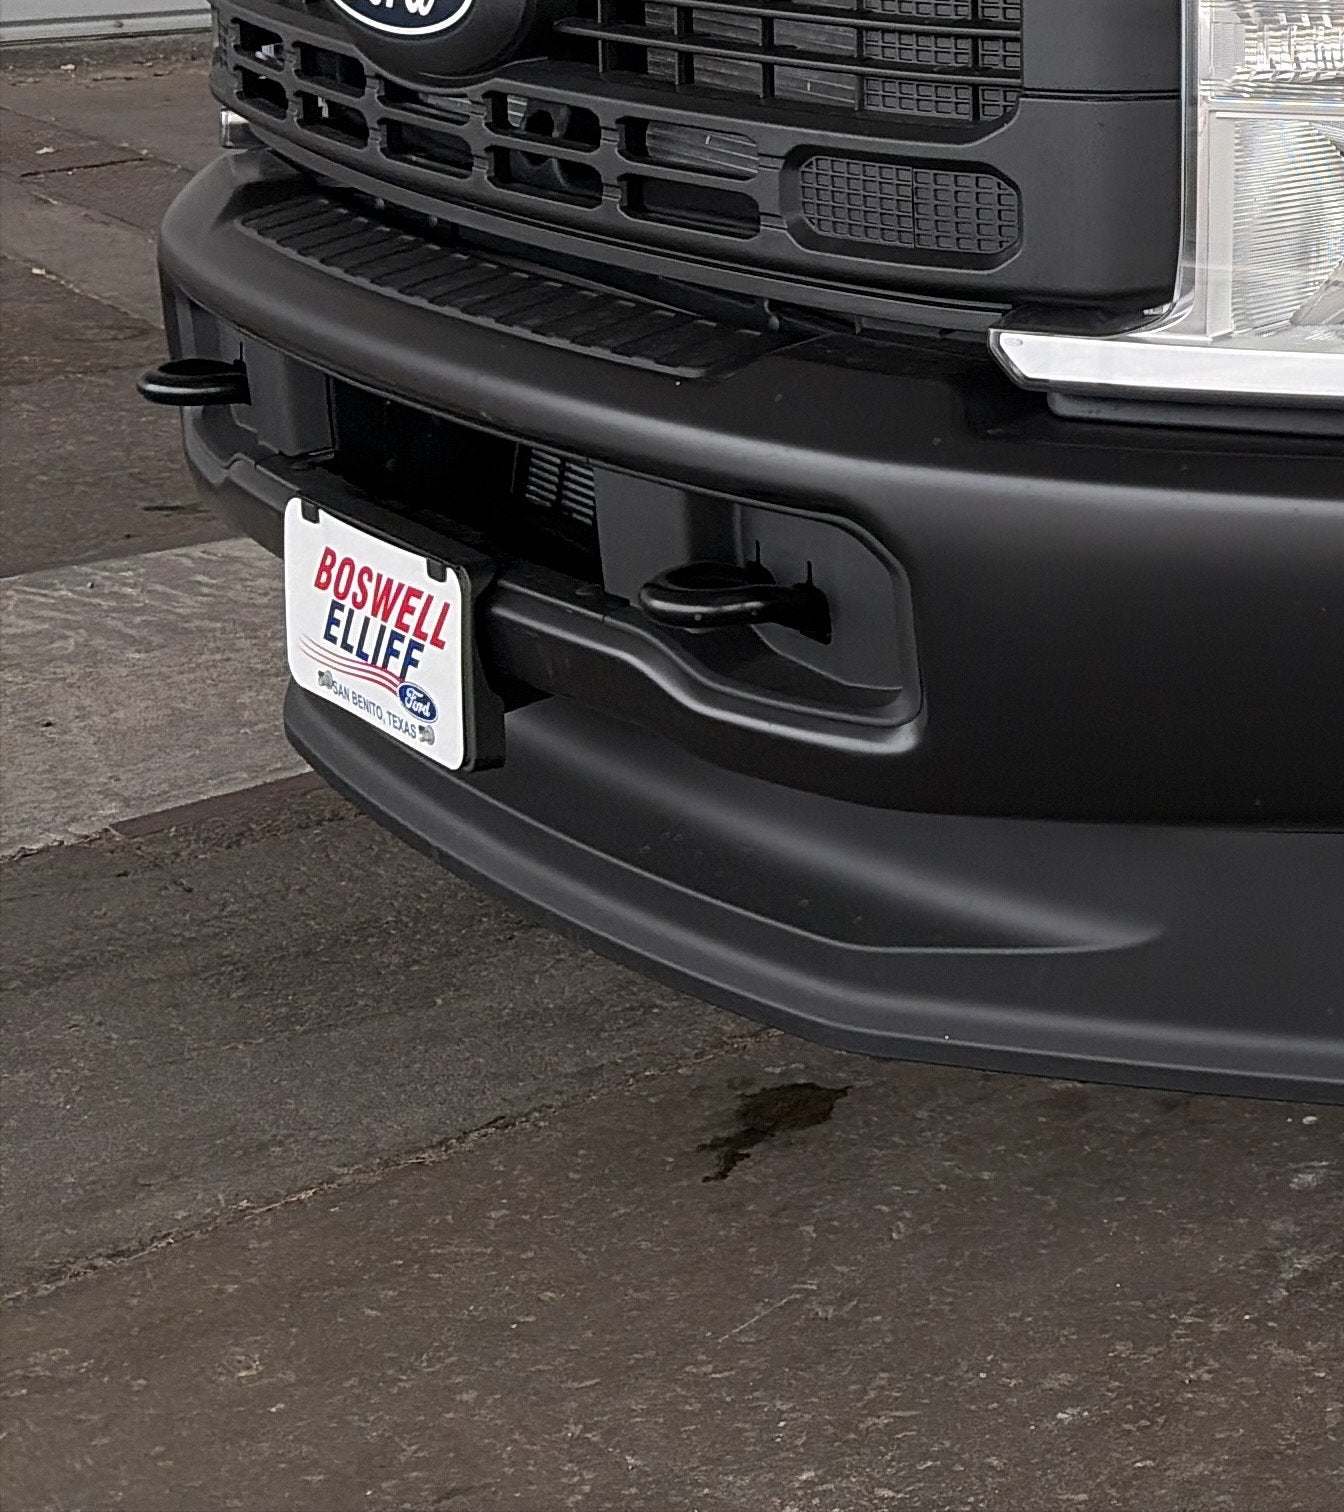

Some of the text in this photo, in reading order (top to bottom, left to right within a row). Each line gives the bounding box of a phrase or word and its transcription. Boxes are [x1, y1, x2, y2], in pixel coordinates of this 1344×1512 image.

[314, 546, 450, 650] BOSWELL
[323, 599, 425, 682] ELLIFF
[332, 680, 417, 739] SAN BENITO, TEXAS
[404, 688, 431, 717] Ford
